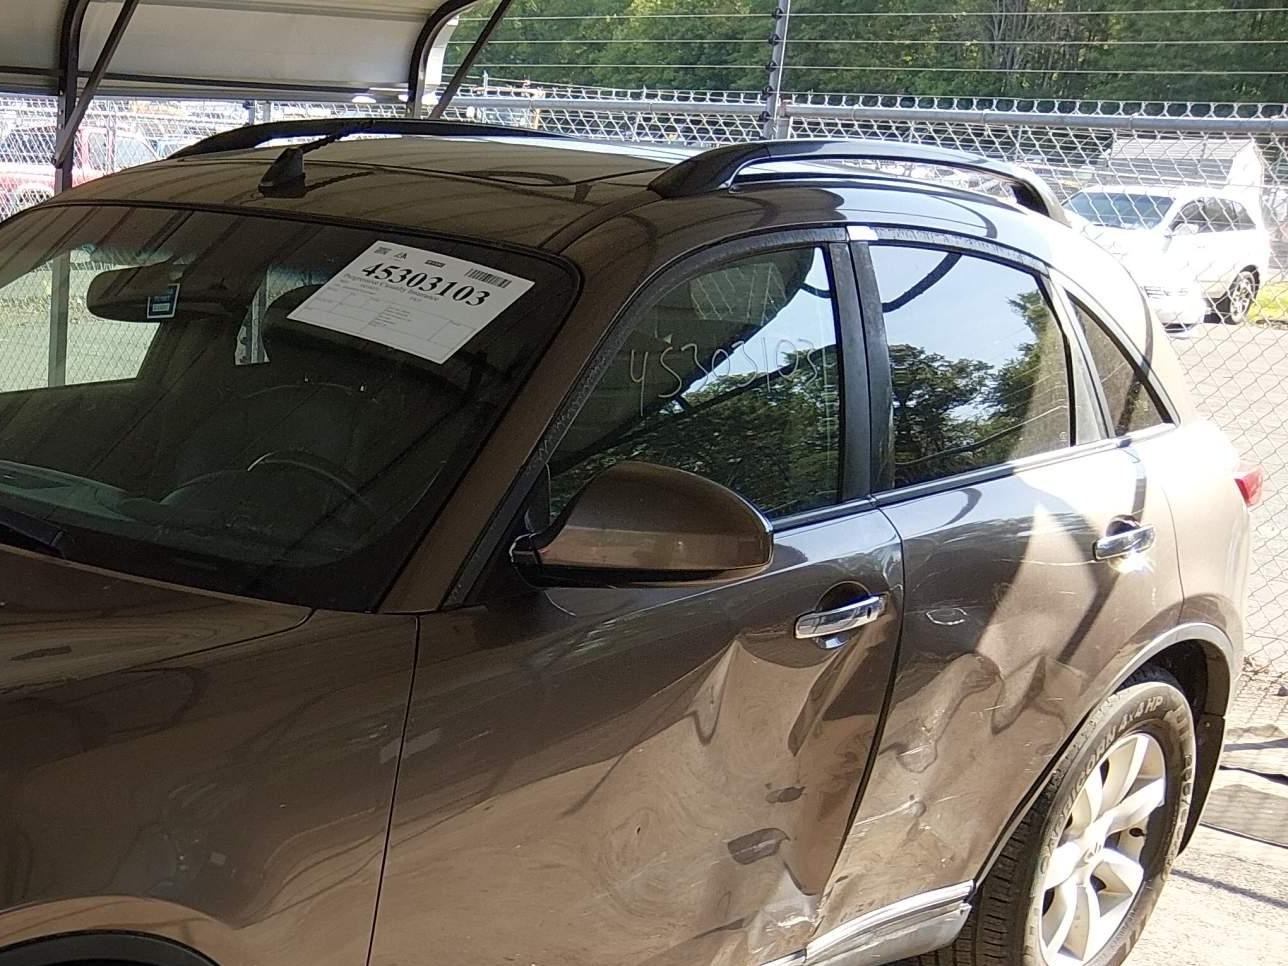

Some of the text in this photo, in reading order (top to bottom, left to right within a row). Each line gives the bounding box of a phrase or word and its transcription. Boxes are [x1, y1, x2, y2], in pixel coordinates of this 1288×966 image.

[362, 262, 491, 307] 45303103
[630, 337, 819, 418] 45303103
[1144, 695, 1163, 714] HP
